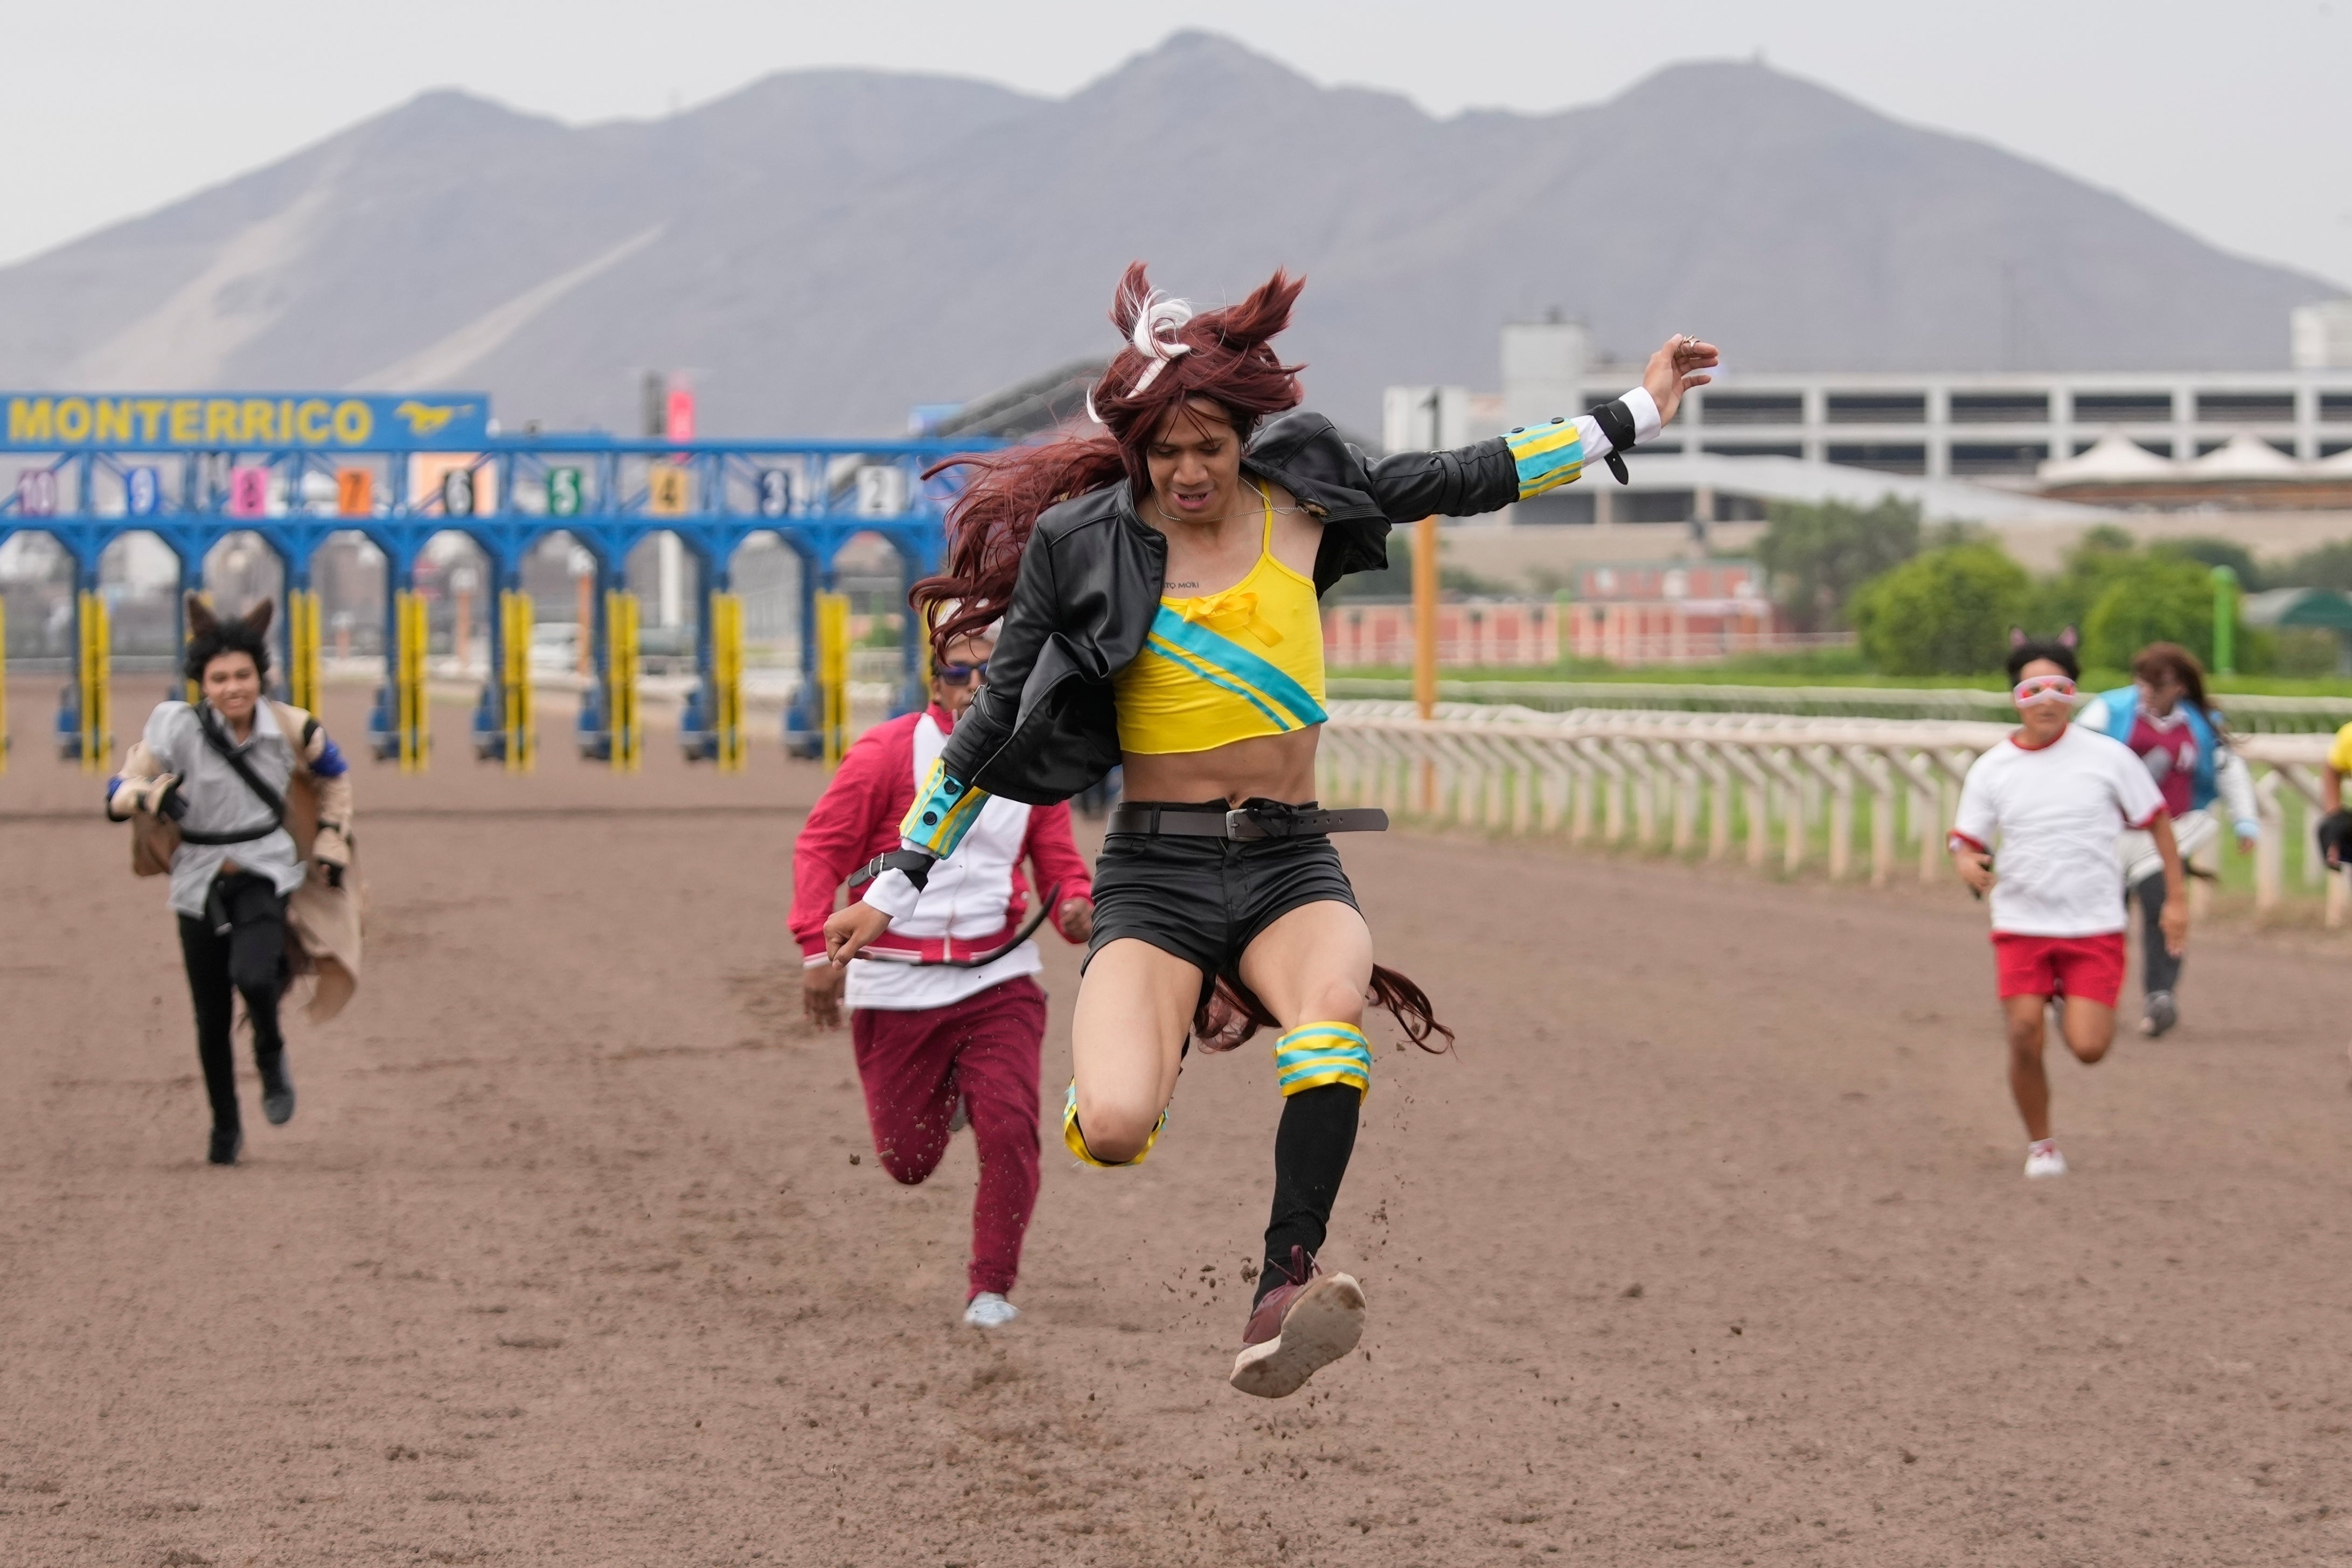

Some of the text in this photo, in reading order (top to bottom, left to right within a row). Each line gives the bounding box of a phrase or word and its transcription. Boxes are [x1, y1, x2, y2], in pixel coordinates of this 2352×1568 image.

[10, 397, 374, 446] MONTERRICO
[19, 470, 56, 515] 10
[130, 468, 155, 514] 9
[240, 470, 261, 511] 8
[347, 472, 365, 512] 7
[446, 469, 470, 516] 6
[552, 469, 577, 516] 5
[660, 469, 679, 510] 4
[762, 469, 788, 517] 3
[867, 468, 887, 511] 2
